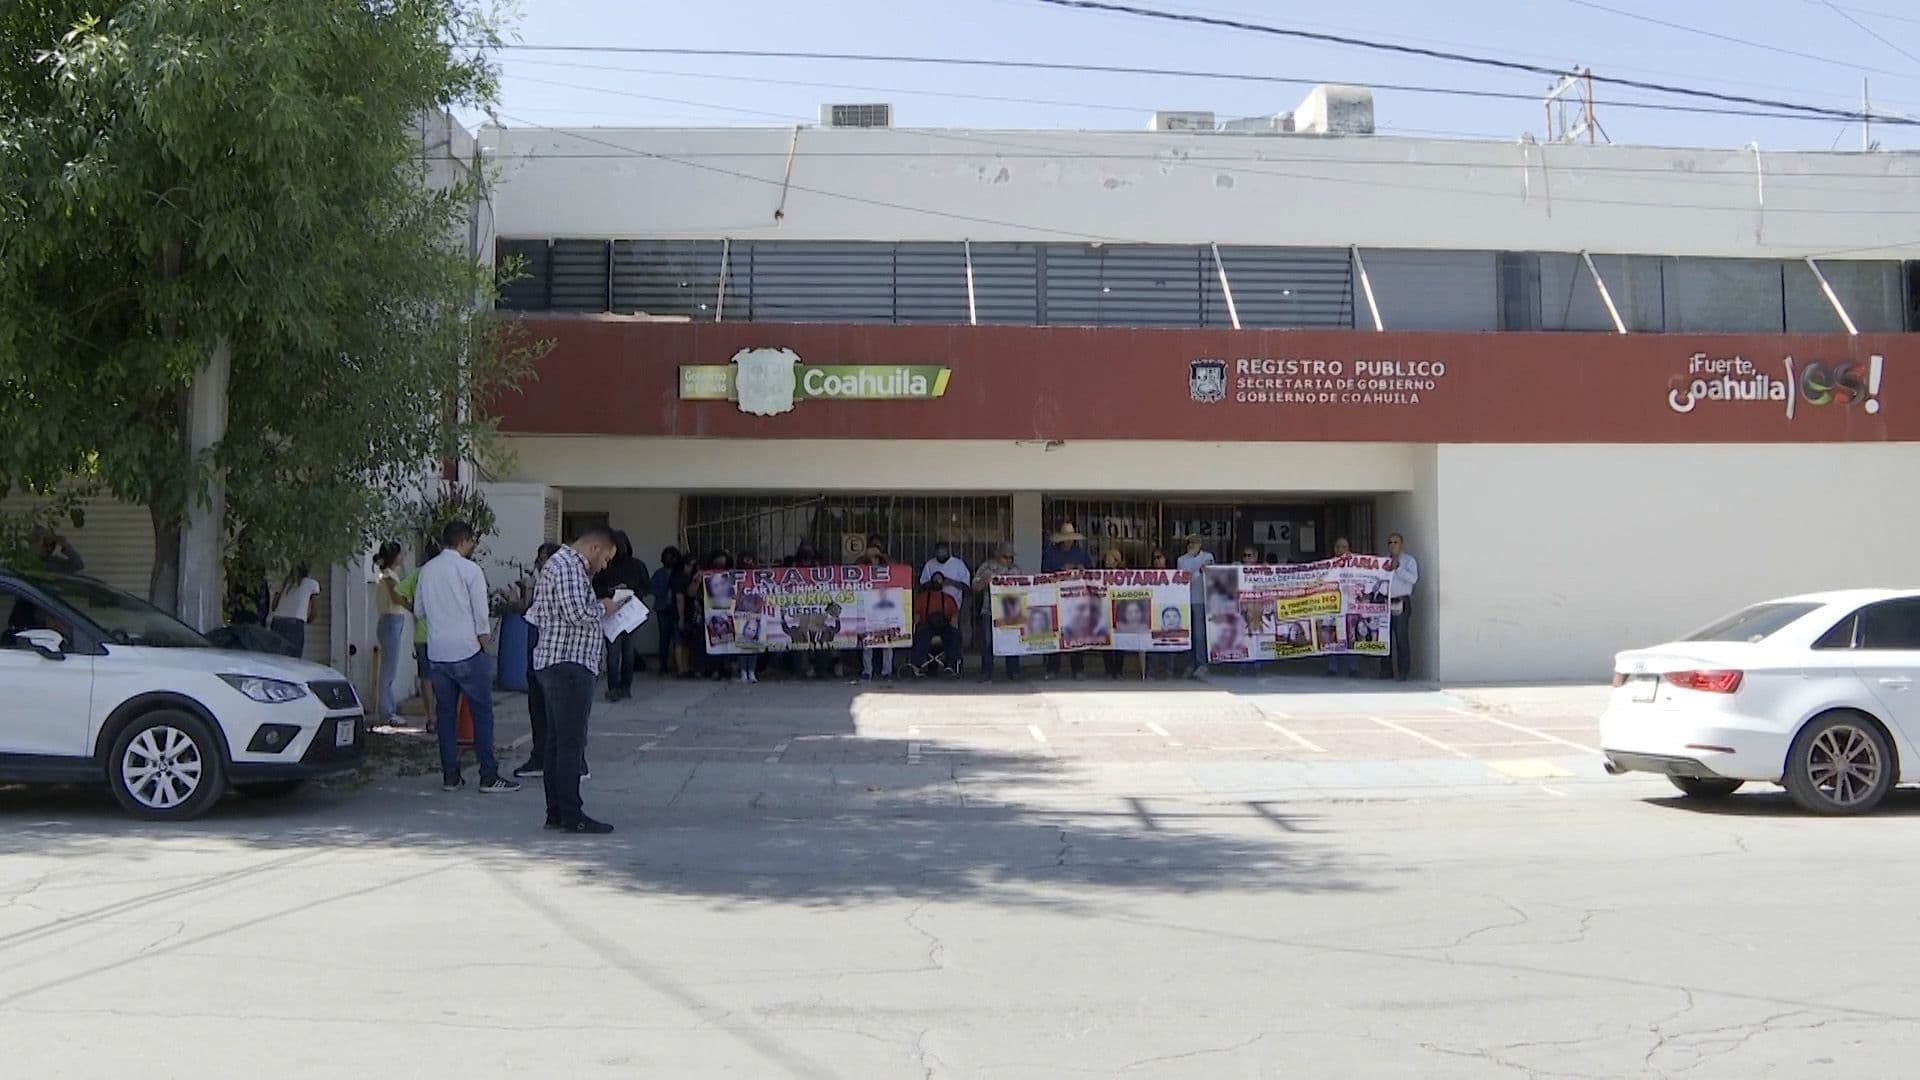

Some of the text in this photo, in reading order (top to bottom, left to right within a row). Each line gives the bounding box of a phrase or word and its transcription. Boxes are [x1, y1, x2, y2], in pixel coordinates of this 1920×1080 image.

[1236, 358, 1446, 377] REGISTRO PUBLICO
[803, 367, 927, 397] Coahuila
[1236, 377, 1436, 391] SECRETARIA DE GOBIERNO
[1236, 391, 1420, 405] GOBIERNO DE COAHUILA
[728, 564, 891, 585] FRAUDE
[1103, 570, 1170, 587] NOTARIA
[743, 580, 874, 595] CARTEL INMOBILIARIO
[766, 592, 832, 607] NOTARIA
